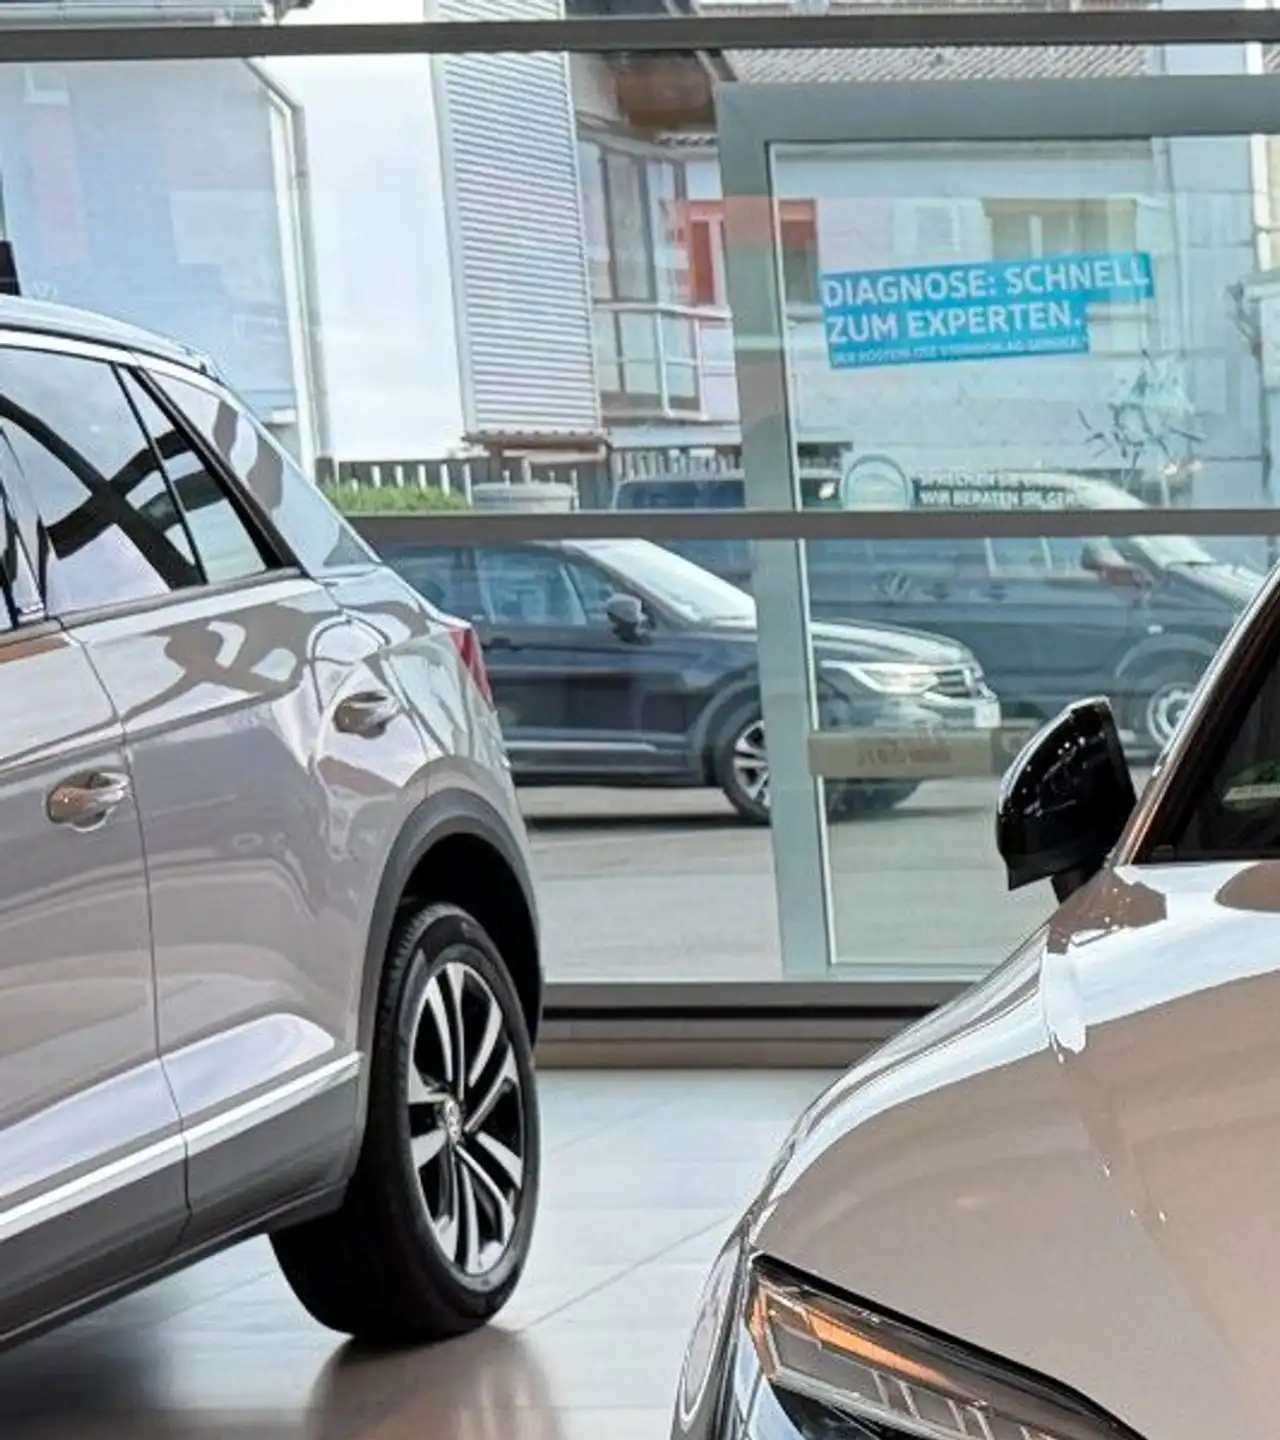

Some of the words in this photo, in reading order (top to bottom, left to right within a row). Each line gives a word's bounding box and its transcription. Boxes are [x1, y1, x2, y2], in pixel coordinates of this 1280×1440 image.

[823, 269, 997, 307] DIAGNOSE:
[1005, 257, 1149, 294] SCHNELL
[827, 313, 899, 345] ZUM
[907, 302, 1081, 338] EXPERTEN.
